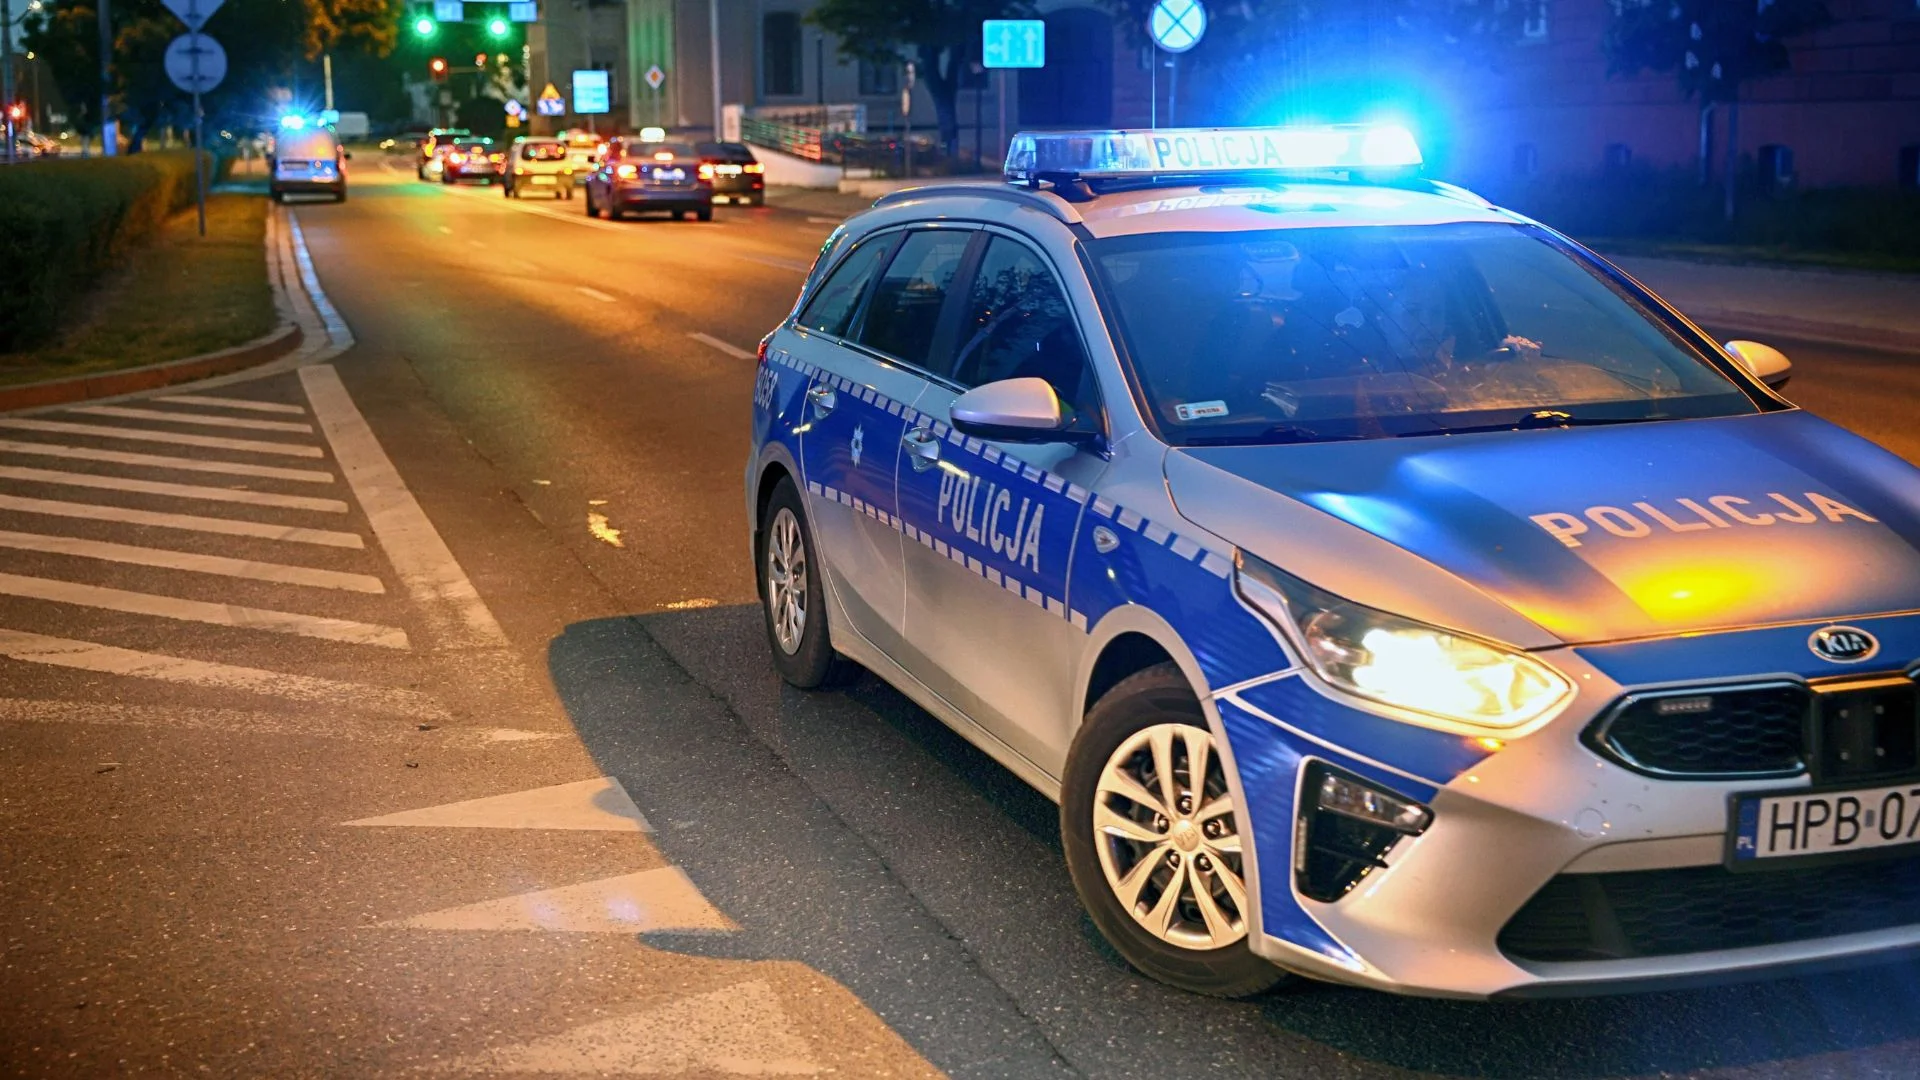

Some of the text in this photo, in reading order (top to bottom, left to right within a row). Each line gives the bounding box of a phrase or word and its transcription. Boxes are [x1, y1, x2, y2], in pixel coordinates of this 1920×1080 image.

[1153, 136, 1283, 168] POLICJA
[938, 469, 1045, 574] POLICJA
[1528, 492, 1880, 549] POLICJA
[1820, 632, 1868, 653] KIA
[1736, 836, 1754, 849] PL
[1768, 796, 1861, 851] HPB
